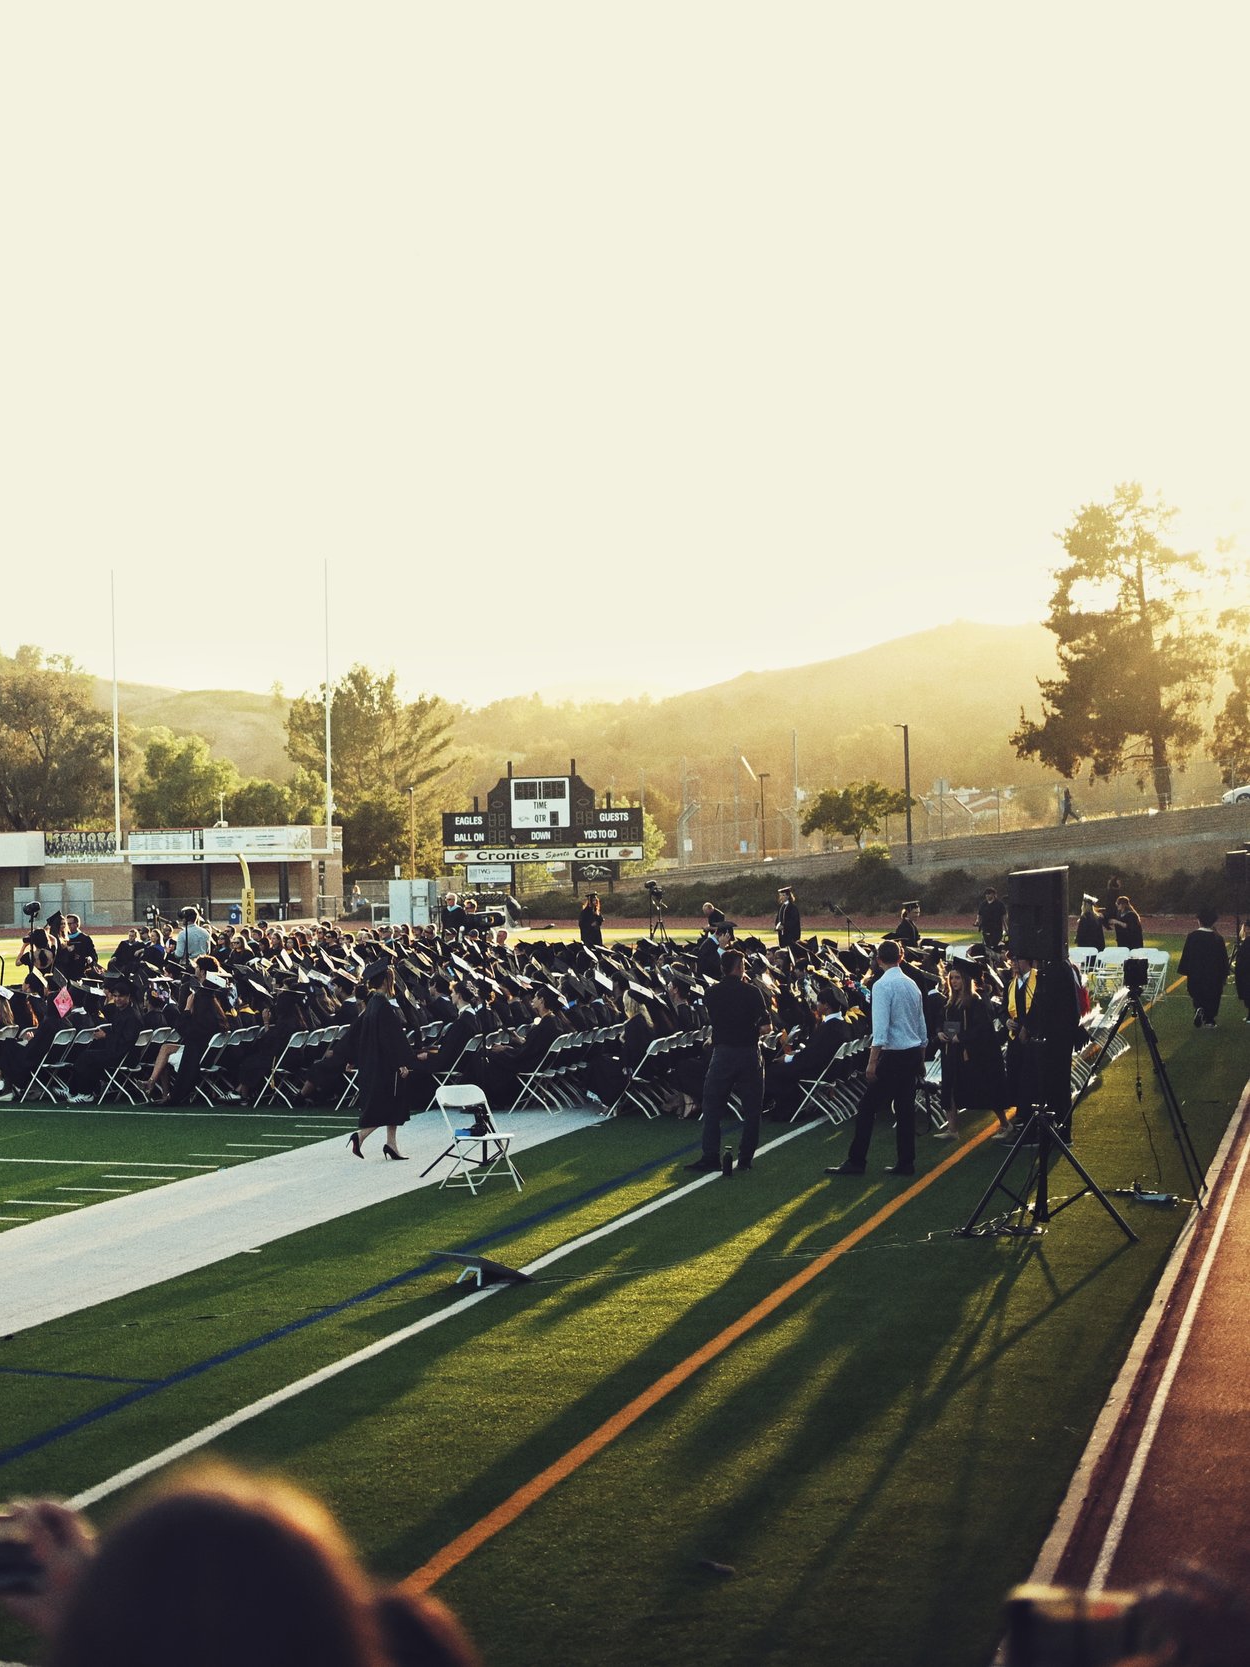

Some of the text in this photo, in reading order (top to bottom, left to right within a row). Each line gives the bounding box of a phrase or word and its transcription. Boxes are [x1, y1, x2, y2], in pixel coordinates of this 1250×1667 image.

[533, 801, 547, 810] TIME
[455, 816, 483, 825] EAGLES
[534, 814, 547, 823] QTR
[599, 812, 629, 822] GUESTS
[454, 833, 485, 842] BALL ON
[531, 831, 551, 840] DOWN
[584, 830, 618, 839] YDS TO GO
[476, 849, 609, 861] Cronies Sports Grill
